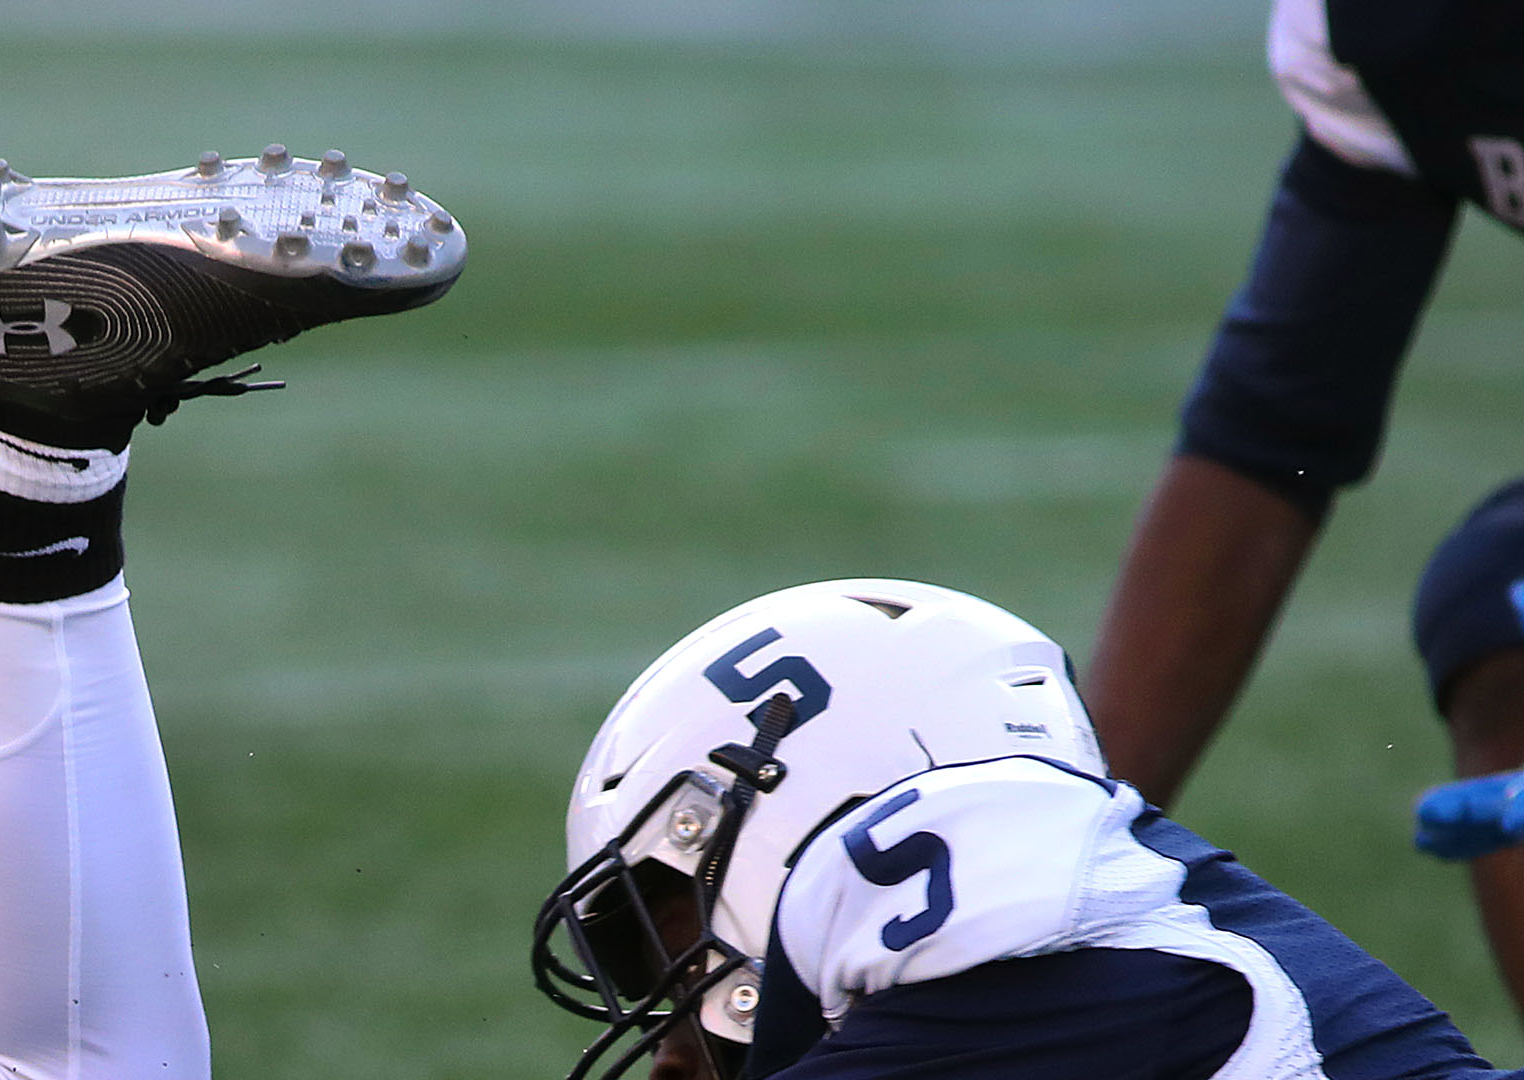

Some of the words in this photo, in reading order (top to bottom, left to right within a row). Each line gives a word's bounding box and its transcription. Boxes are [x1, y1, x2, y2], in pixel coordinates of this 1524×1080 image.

[30, 214, 118, 226] UNDER
[126, 205, 220, 223] ARMOU
[703, 627, 833, 738] 5
[843, 788, 954, 952] 5
